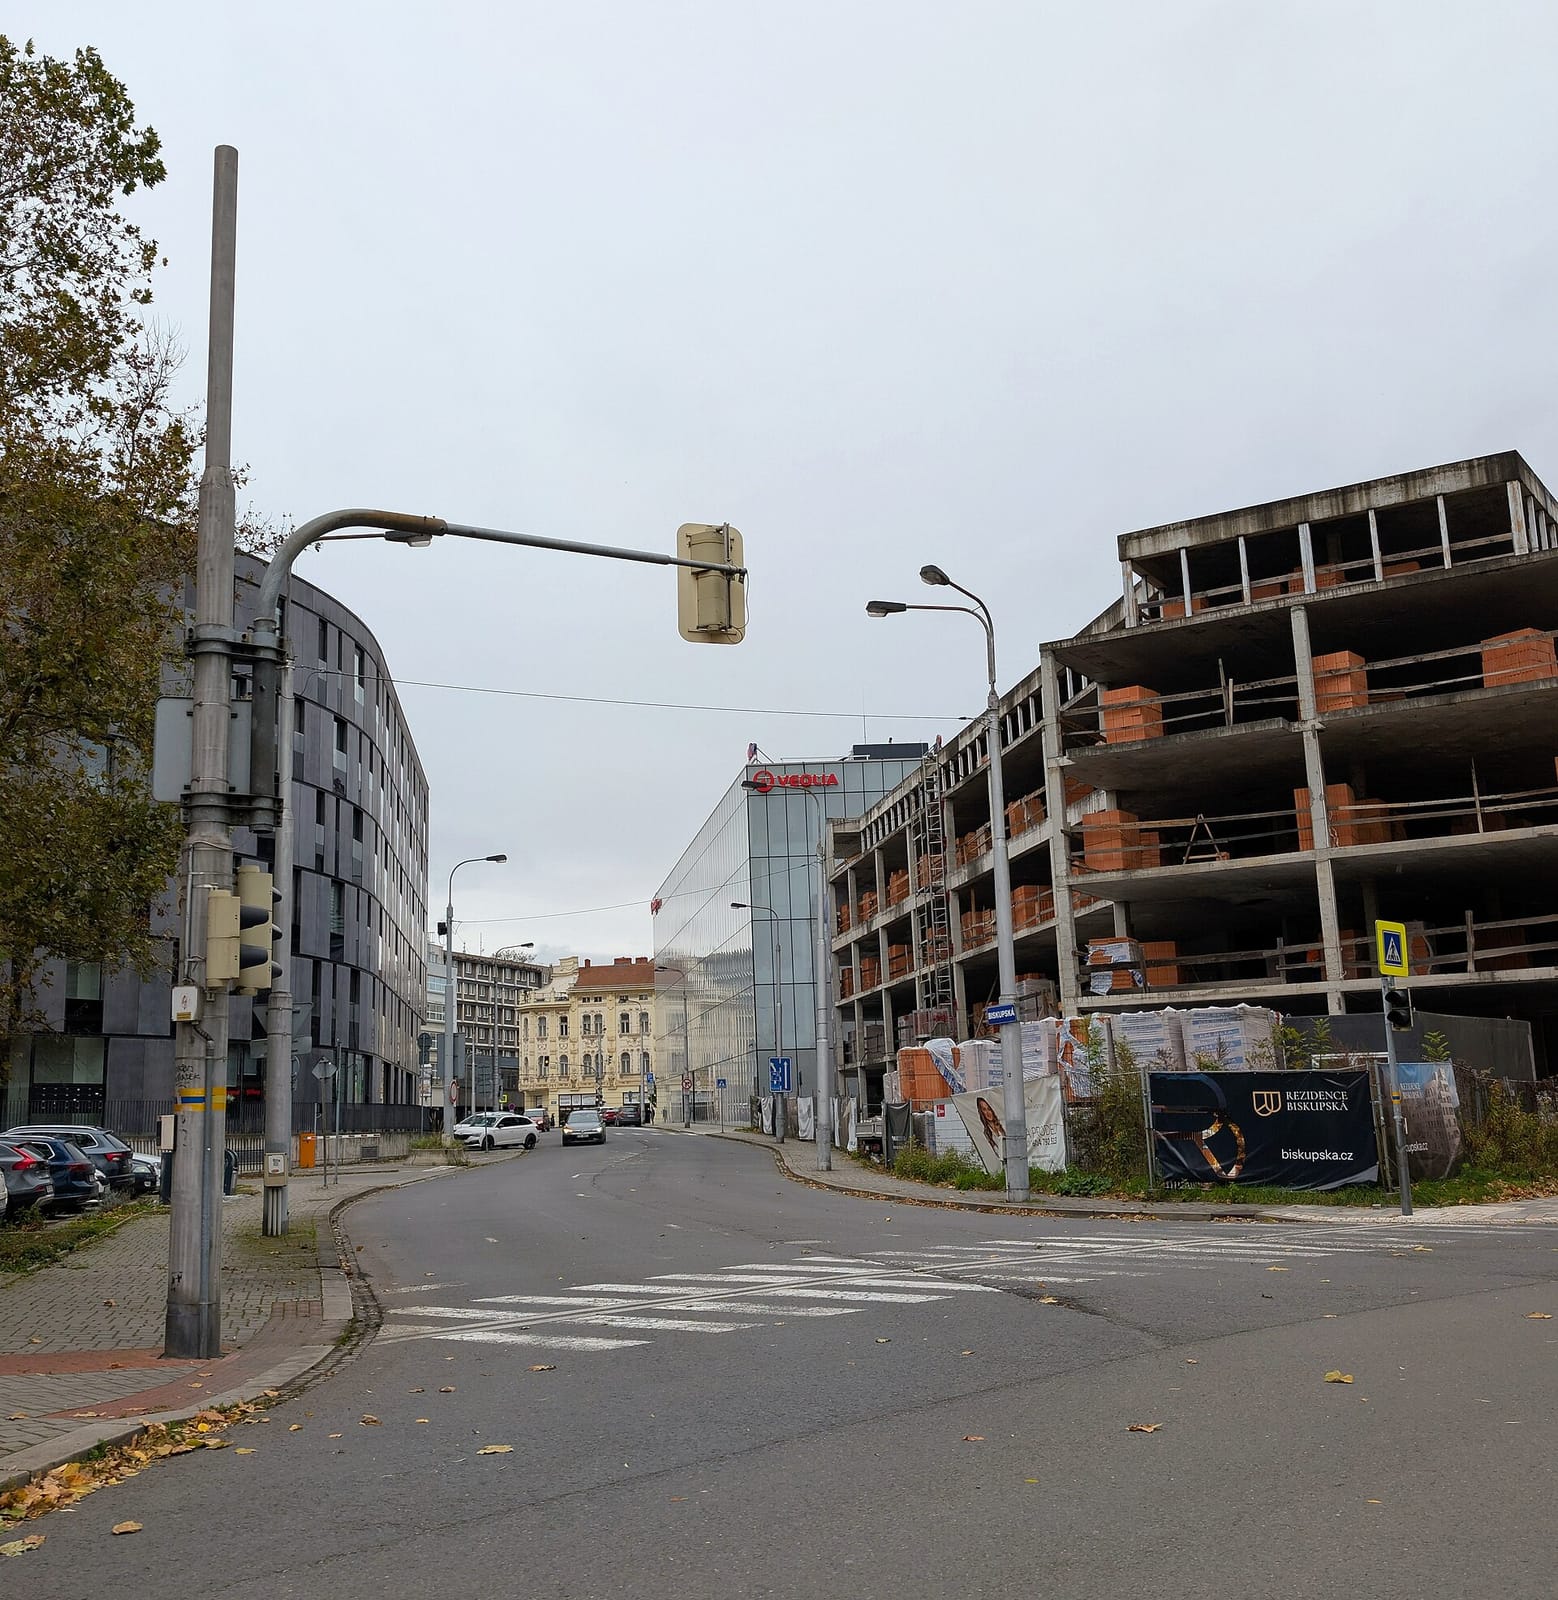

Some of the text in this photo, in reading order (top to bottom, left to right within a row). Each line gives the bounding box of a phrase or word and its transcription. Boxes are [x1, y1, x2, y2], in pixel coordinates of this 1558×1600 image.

[777, 773, 839, 787] VEOLIA
[1286, 1091, 1348, 1101] REZIDENCE
[1287, 1100, 1348, 1111] BISKUPSKÁ
[1281, 1148, 1354, 1162] biskupska.cz
